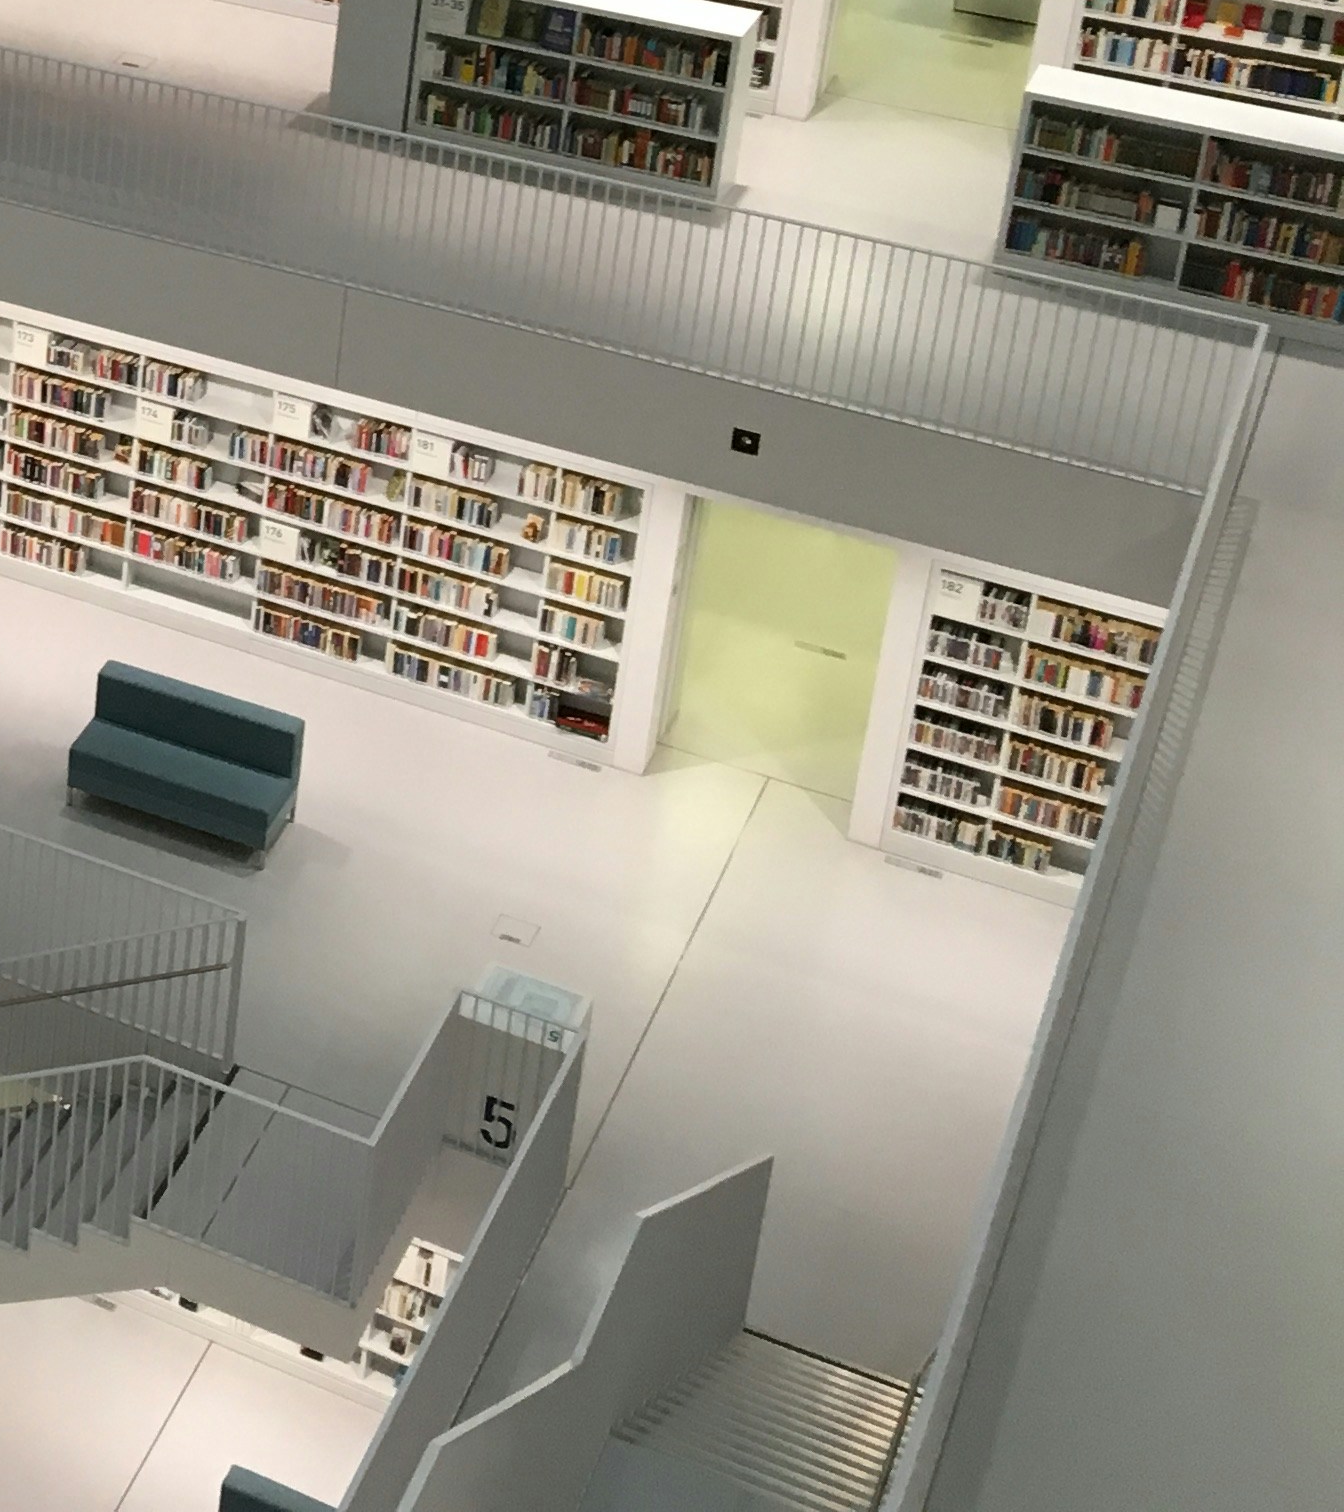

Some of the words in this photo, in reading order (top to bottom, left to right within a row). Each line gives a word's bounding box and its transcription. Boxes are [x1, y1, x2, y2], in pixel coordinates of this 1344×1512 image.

[141, 406, 158, 419] 174
[277, 400, 296, 414] 175
[941, 579, 964, 594] 182
[480, 1095, 515, 1149] 5
